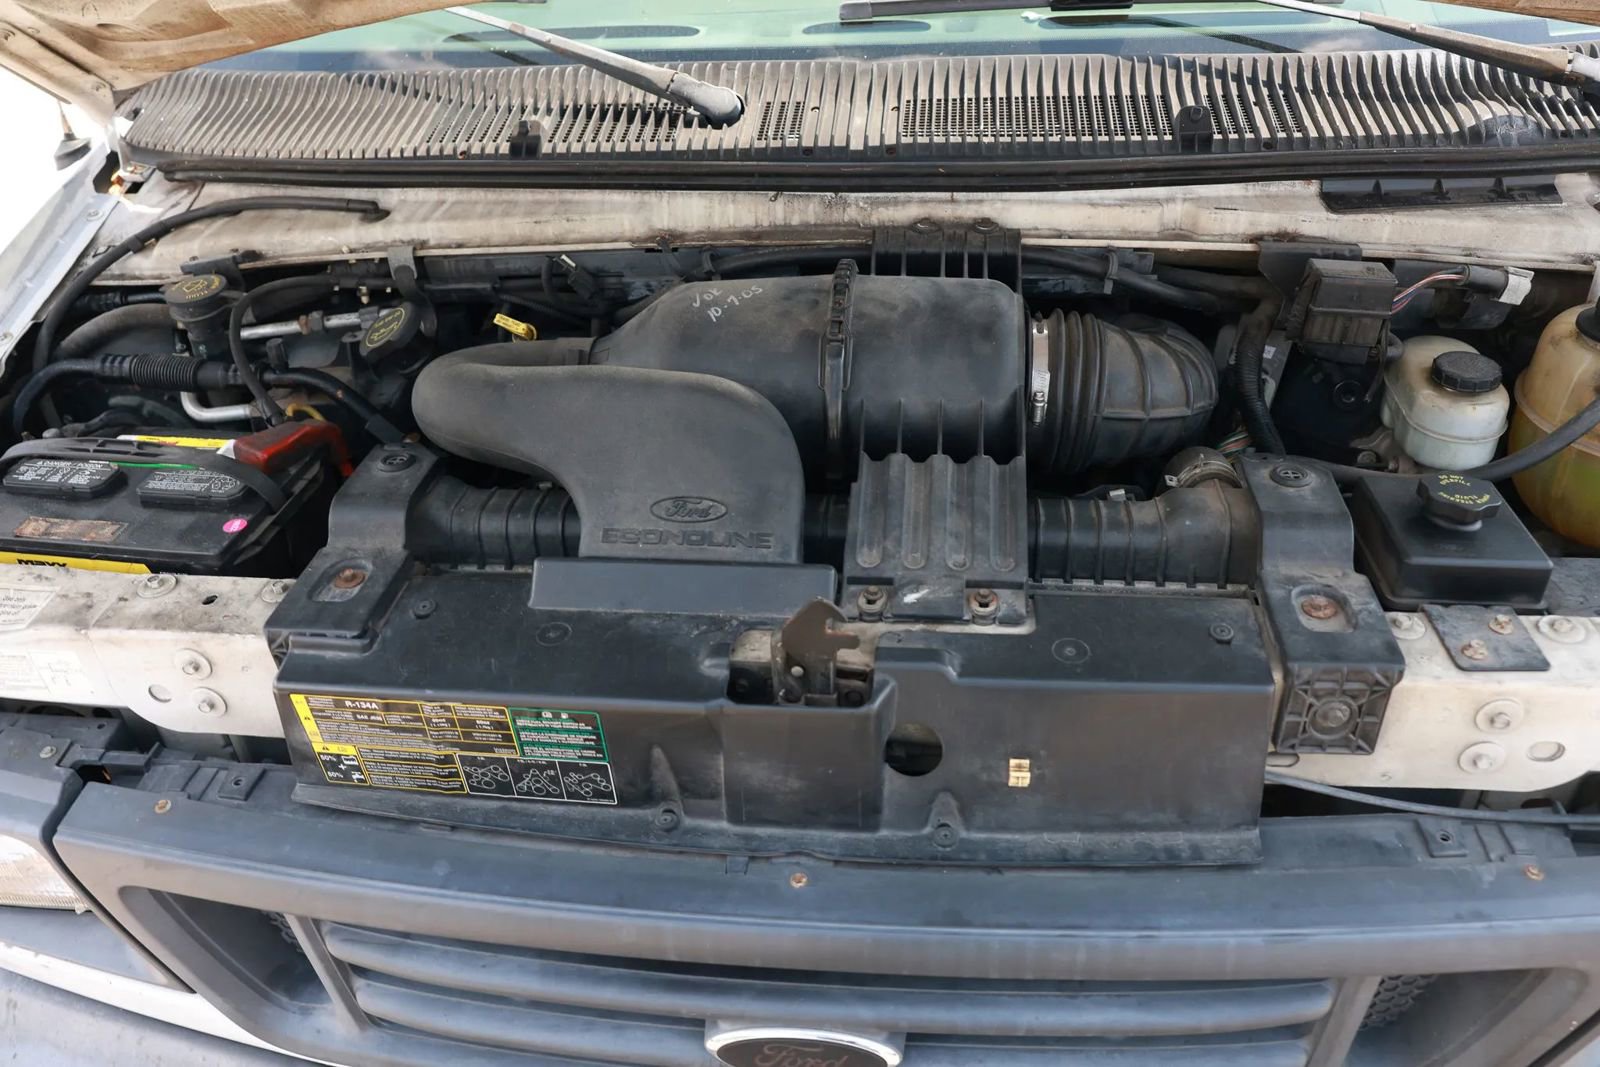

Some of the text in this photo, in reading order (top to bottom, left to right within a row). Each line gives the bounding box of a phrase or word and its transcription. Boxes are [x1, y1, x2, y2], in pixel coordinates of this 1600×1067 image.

[665, 500, 715, 519] Ford
[601, 527, 774, 549] ECONOLINE
[344, 700, 379, 710] R-134A
[755, 1043, 849, 1067] Ford
